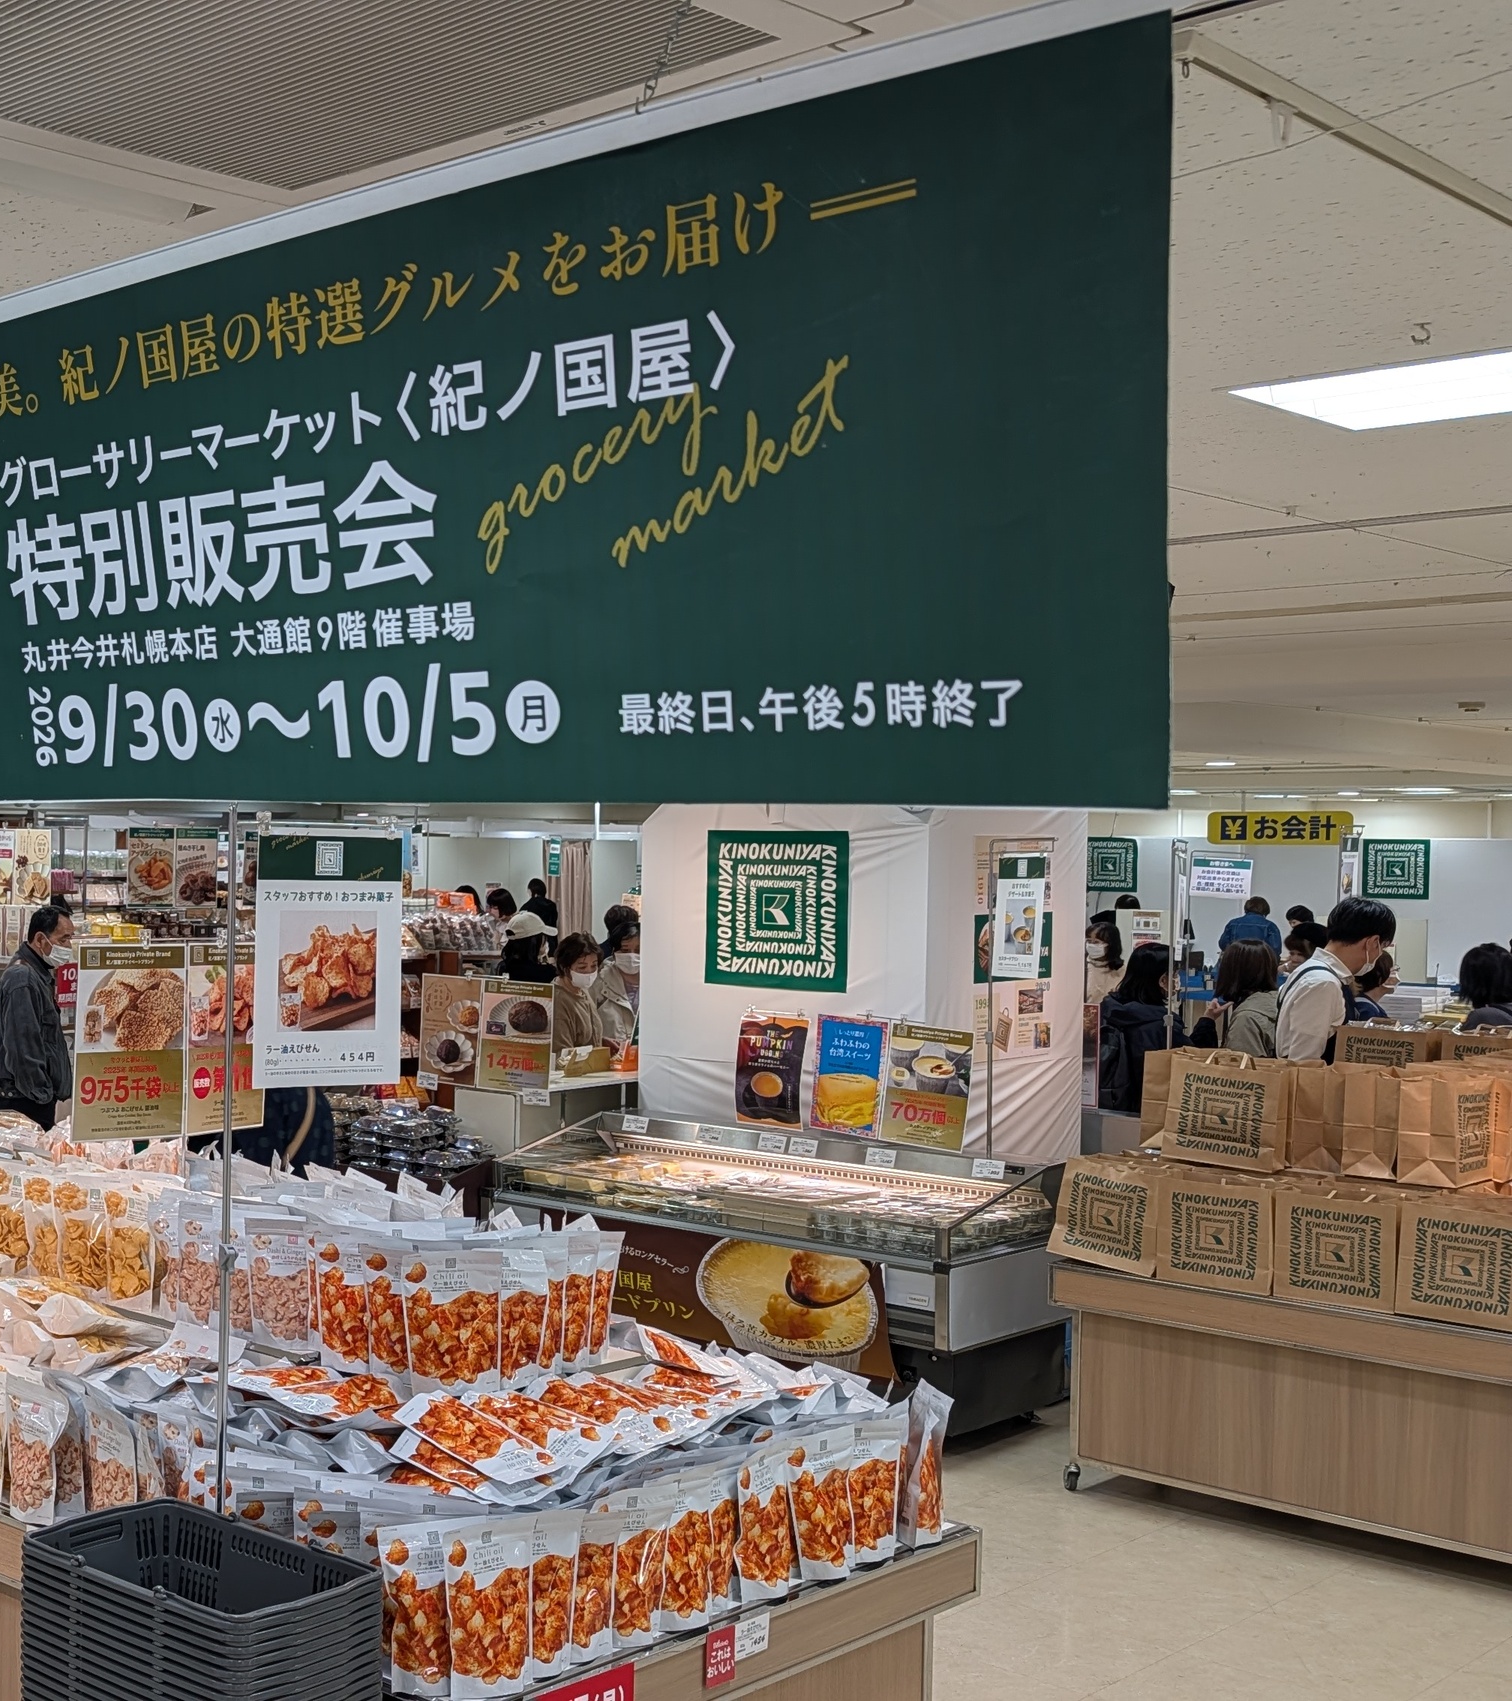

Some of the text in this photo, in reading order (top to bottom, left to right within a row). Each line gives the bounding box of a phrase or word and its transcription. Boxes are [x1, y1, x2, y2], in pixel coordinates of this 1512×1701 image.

[611, 355, 849, 568] market
[477, 382, 717, 574] grocery
[5, 460, 437, 625] 特別販売会
[21, 626, 218, 674] 丸井今井札幌本店
[619, 678, 1023, 735] 最終日、午後5時終了
[28, 686, 58, 767] 2026
[1253, 815, 1337, 840] お会計
[719, 843, 821, 861] KINOKUNIYA
[1369, 843, 1418, 851] KINOKUNIYA
[738, 864, 807, 876] KINOKUNIYA
[1367, 850, 1375, 894] KINOKUNIYA
[1416, 844, 1425, 889] KINOKUNIYA
[264, 891, 394, 902] スタッフおすすめ!おつまみ菓子
[821, 844, 837, 961] KINOKUNIYA
[1374, 887, 1424, 895] KINOKUNIYA
[717, 858, 733, 972] KINOKUNIYA
[736, 875, 747, 951] KINOKUNIYA
[806, 866, 817, 945] KINOKUNIYA
[745, 941, 816, 955] KINOKUNIYA
[731, 956, 836, 978] KINOKUNIYA
[266, 1044, 320, 1054] ラー油えびせん
[750, 1037, 793, 1050] PUMPKIN
[829, 1048, 871, 1060] 台湾スイーツ
[832, 1039, 870, 1049] ふわふわの
[1346, 1036, 1406, 1049] KINOKUNIYA
[80, 1076, 162, 1105] 9万5千袋
[1184, 1073, 1255, 1091] KINOKUNIYA
[891, 1101, 946, 1125] 70万個
[1176, 1082, 1193, 1147] KINOKUNIYA
[1249, 1083, 1265, 1149] KINOKUNIYA
[1187, 1139, 1260, 1158] KINOKUNIYA
[1074, 1172, 1139, 1194] KINOKUNIYA
[1172, 1192, 1249, 1209] KINOKUNIYA
[1063, 1181, 1081, 1244] KINOKUNIYA
[1131, 1187, 1148, 1252] KINOKUNIYA
[1291, 1206, 1370, 1225] KINOKUNIYA
[1171, 1201, 1182, 1269] KINOKUNIYA
[1246, 1200, 1259, 1270] KINOKUNIYA
[1417, 1217, 1502, 1238] KINOKUNIYA
[1073, 1238, 1142, 1261] KINOKUNIYA
[1289, 1216, 1301, 1286] KINOKUNIYA
[1369, 1216, 1381, 1289] KINOKUNIYA
[1181, 1261, 1255, 1280] KINOKUNIYA
[1411, 1227, 1428, 1302] KINOKUNIYA
[1497, 1228, 1512, 1305] KINOKUNIYA
[1300, 1278, 1380, 1299] KINOKUNIYA
[1422, 1293, 1509, 1315] KINOKUNIYA
[473, 1551, 492, 1559] Chili
[710, 1646, 731, 1663] これは
[707, 1660, 734, 1678] おいしい
